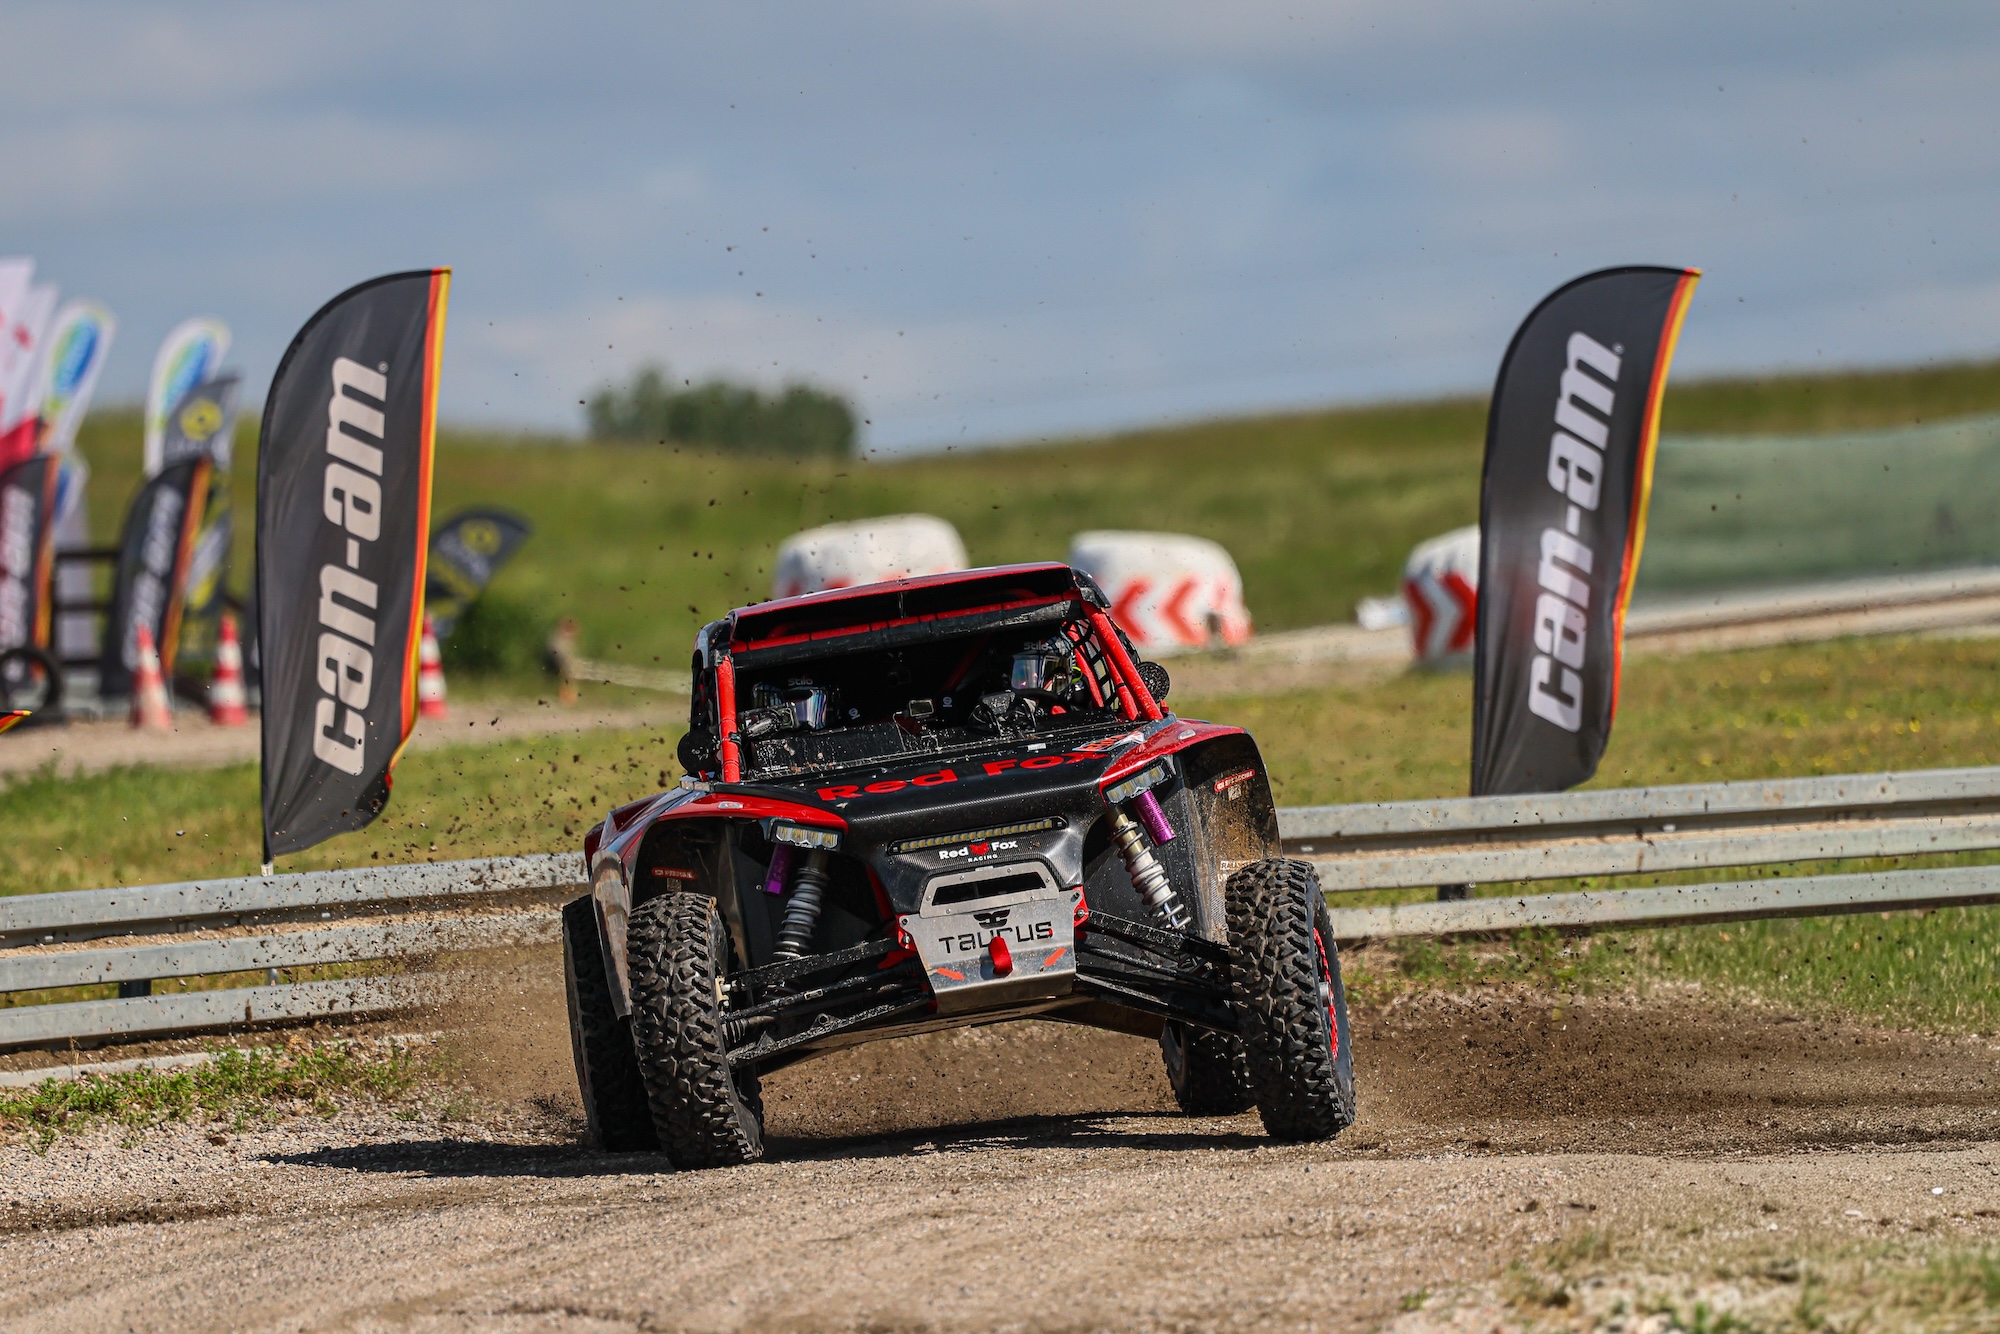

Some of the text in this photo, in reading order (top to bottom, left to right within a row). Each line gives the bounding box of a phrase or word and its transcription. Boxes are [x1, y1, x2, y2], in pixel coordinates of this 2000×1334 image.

[787, 677, 814, 687] Stilo
[816, 769, 957, 801] Red
[938, 847, 969, 860] Red
[991, 840, 1019, 851] Fox
[967, 853, 999, 863] RACING
